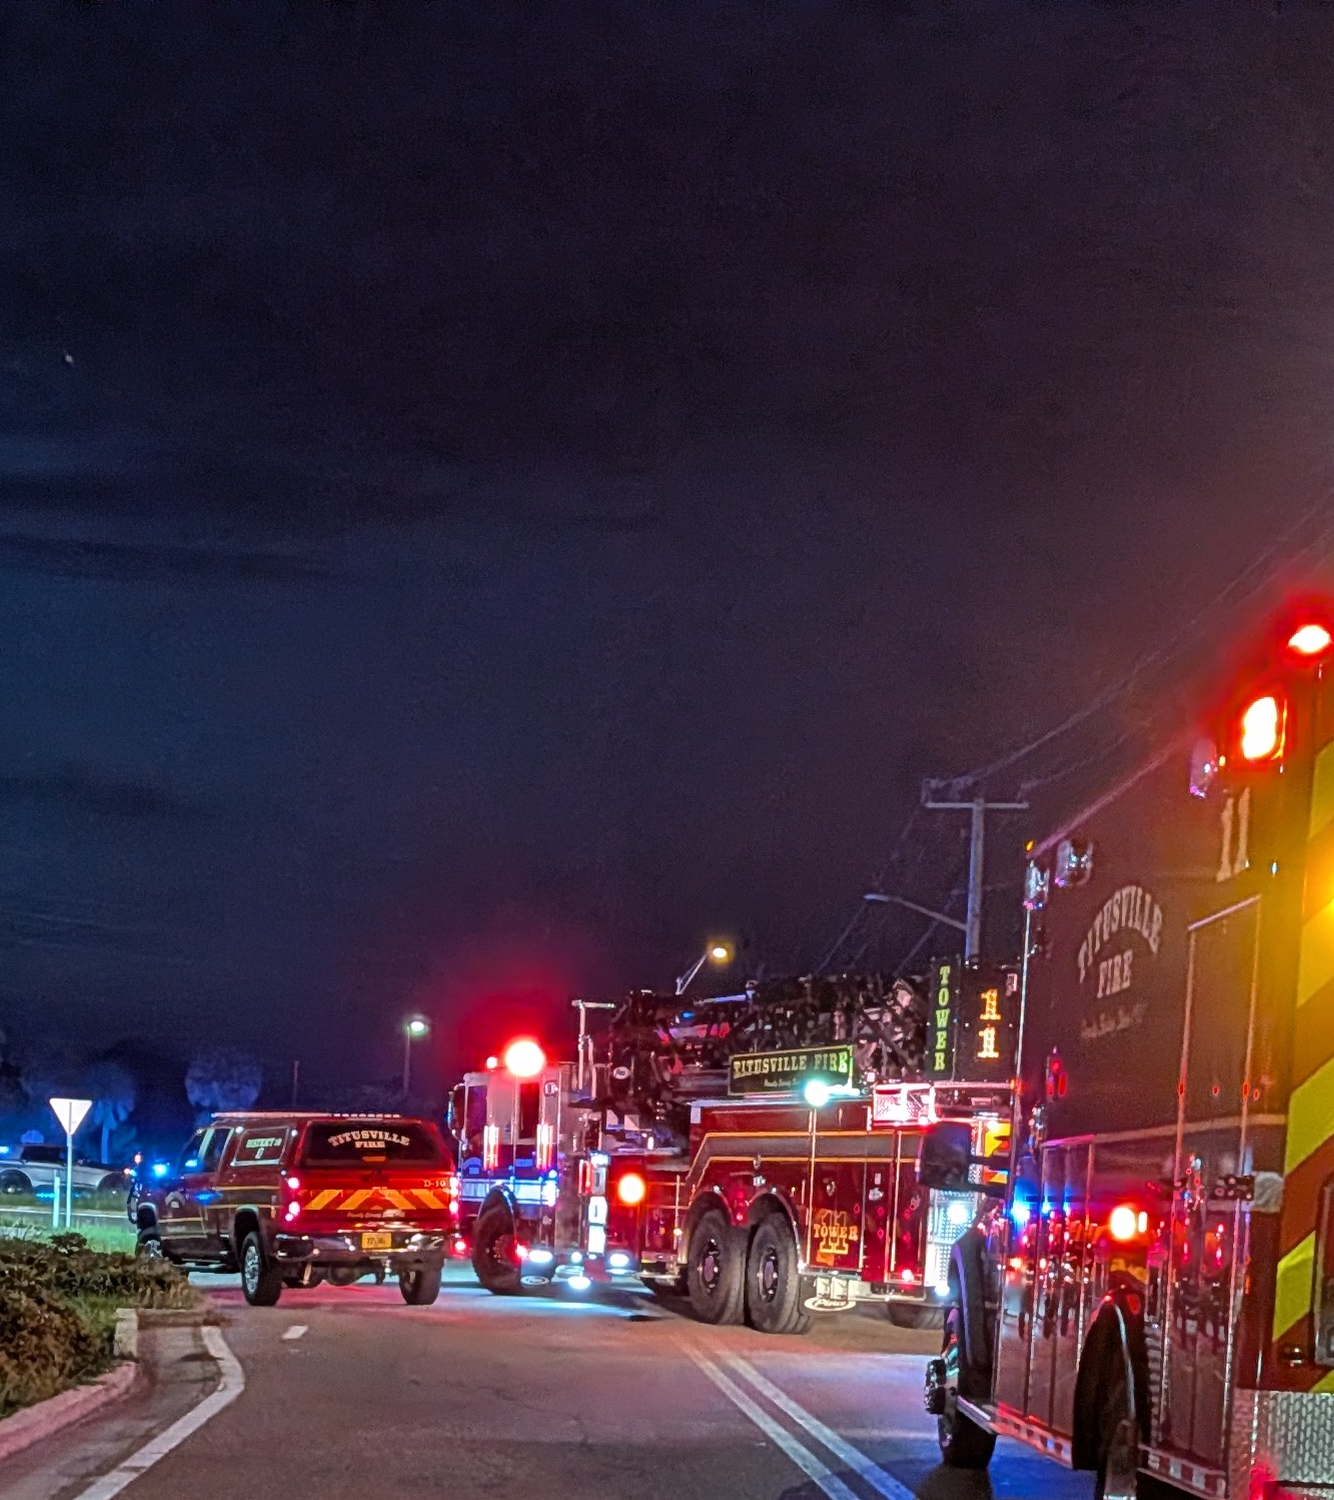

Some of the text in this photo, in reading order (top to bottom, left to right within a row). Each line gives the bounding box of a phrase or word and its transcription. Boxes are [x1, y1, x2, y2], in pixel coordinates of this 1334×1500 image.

[1077, 885, 1163, 986] TITUSVILLE
[1096, 949, 1133, 999] FIRE
[933, 965, 951, 1071] TOWER
[733, 1051, 848, 1079] TITUSVILLE FIRE
[328, 1130, 411, 1147] TITUSVILLE
[354, 1141, 386, 1149] FIRE
[423, 1179, 447, 1188] D-10
[813, 1223, 859, 1241] TOWER
